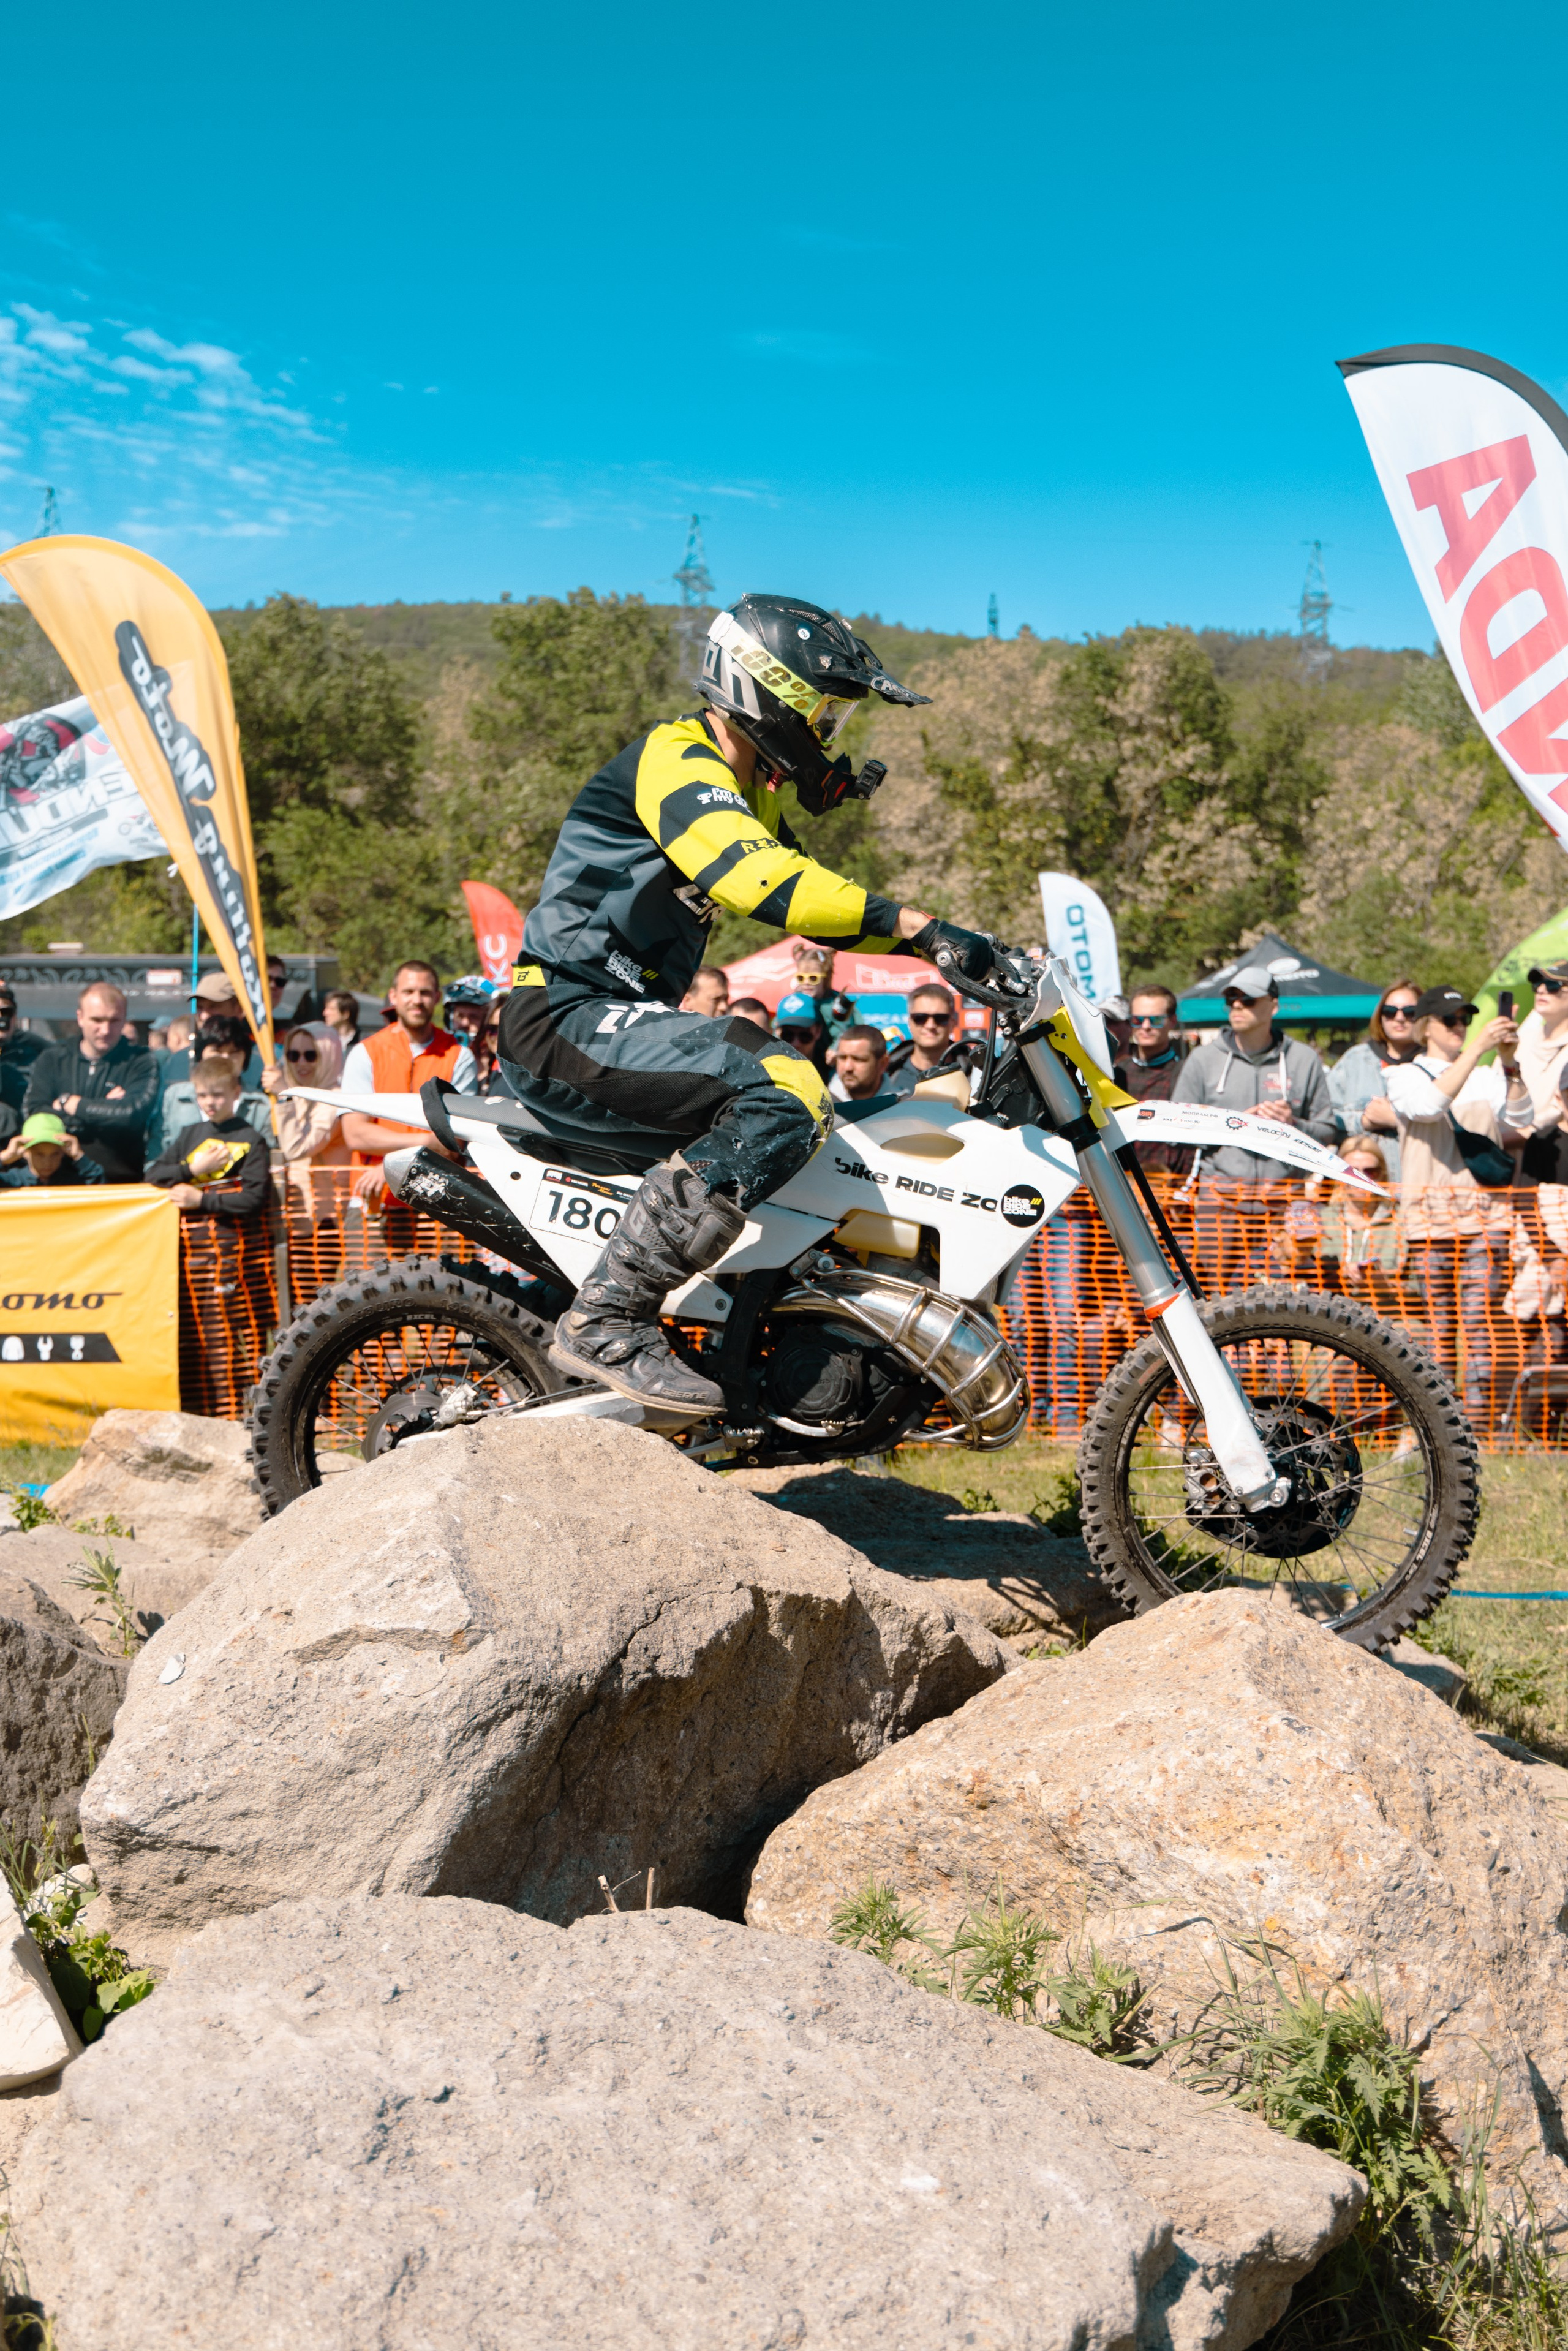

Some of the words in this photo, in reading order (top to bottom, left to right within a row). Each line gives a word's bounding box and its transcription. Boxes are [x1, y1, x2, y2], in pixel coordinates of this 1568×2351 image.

[731, 638, 818, 710] 100%
[606, 957, 642, 982] RIDE
[609, 949, 643, 971] bike
[604, 965, 646, 994] ZONE
[834, 1157, 889, 1185] bike
[895, 1176, 956, 1202] RIDE
[1003, 1195, 1030, 1204] bike
[548, 1190, 622, 1240] 180
